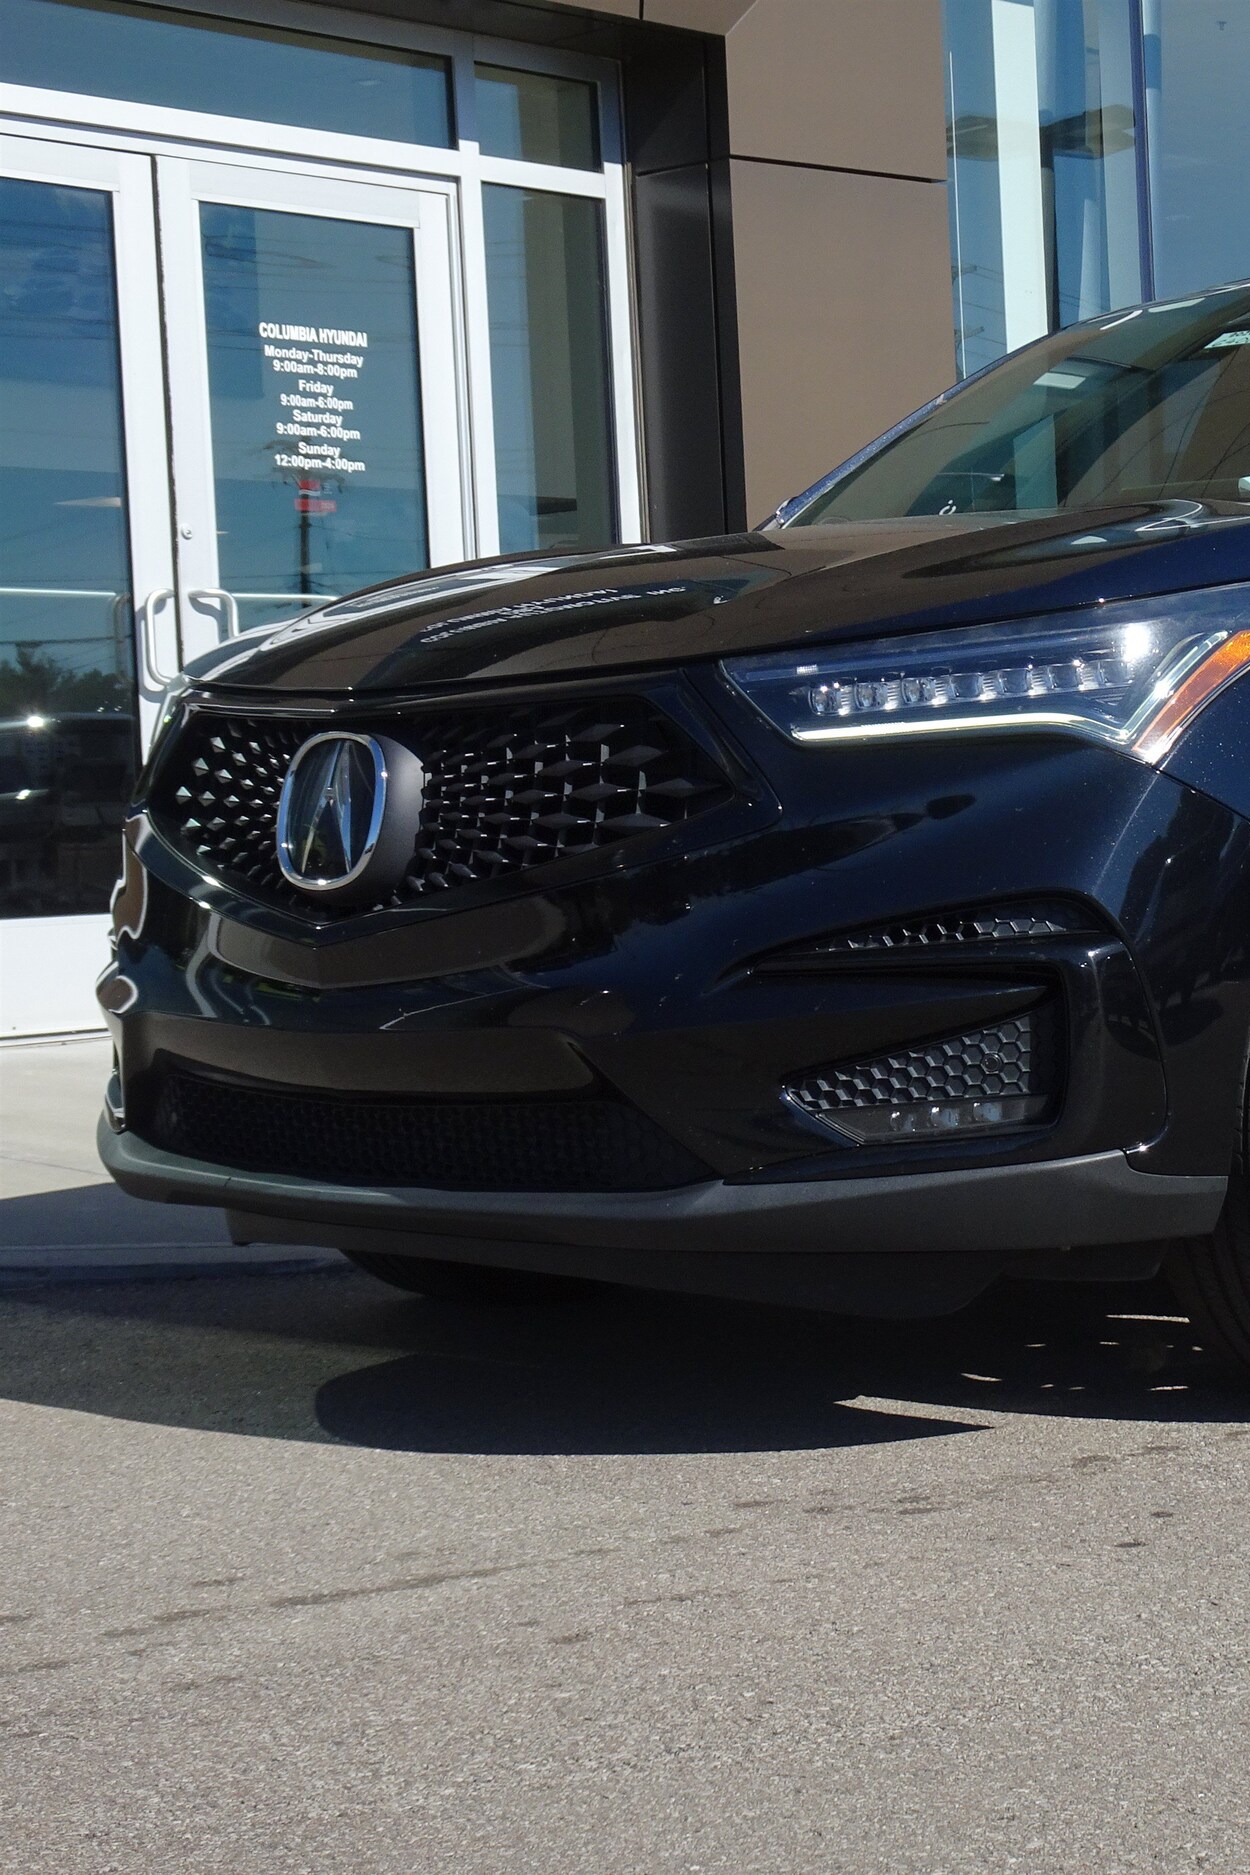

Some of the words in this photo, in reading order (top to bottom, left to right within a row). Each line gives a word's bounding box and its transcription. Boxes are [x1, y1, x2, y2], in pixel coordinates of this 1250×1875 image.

[259, 322, 318, 343] COLUMBIA
[319, 328, 368, 347] HYUNDAI
[264, 345, 364, 368] Monday-Thursday
[272, 359, 358, 379] 9:00am-8:00pm
[298, 379, 334, 396] Friday
[292, 409, 343, 427] Saturday
[298, 441, 341, 458] Sunday
[274, 454, 366, 473] 12:00pm-4:00pm
